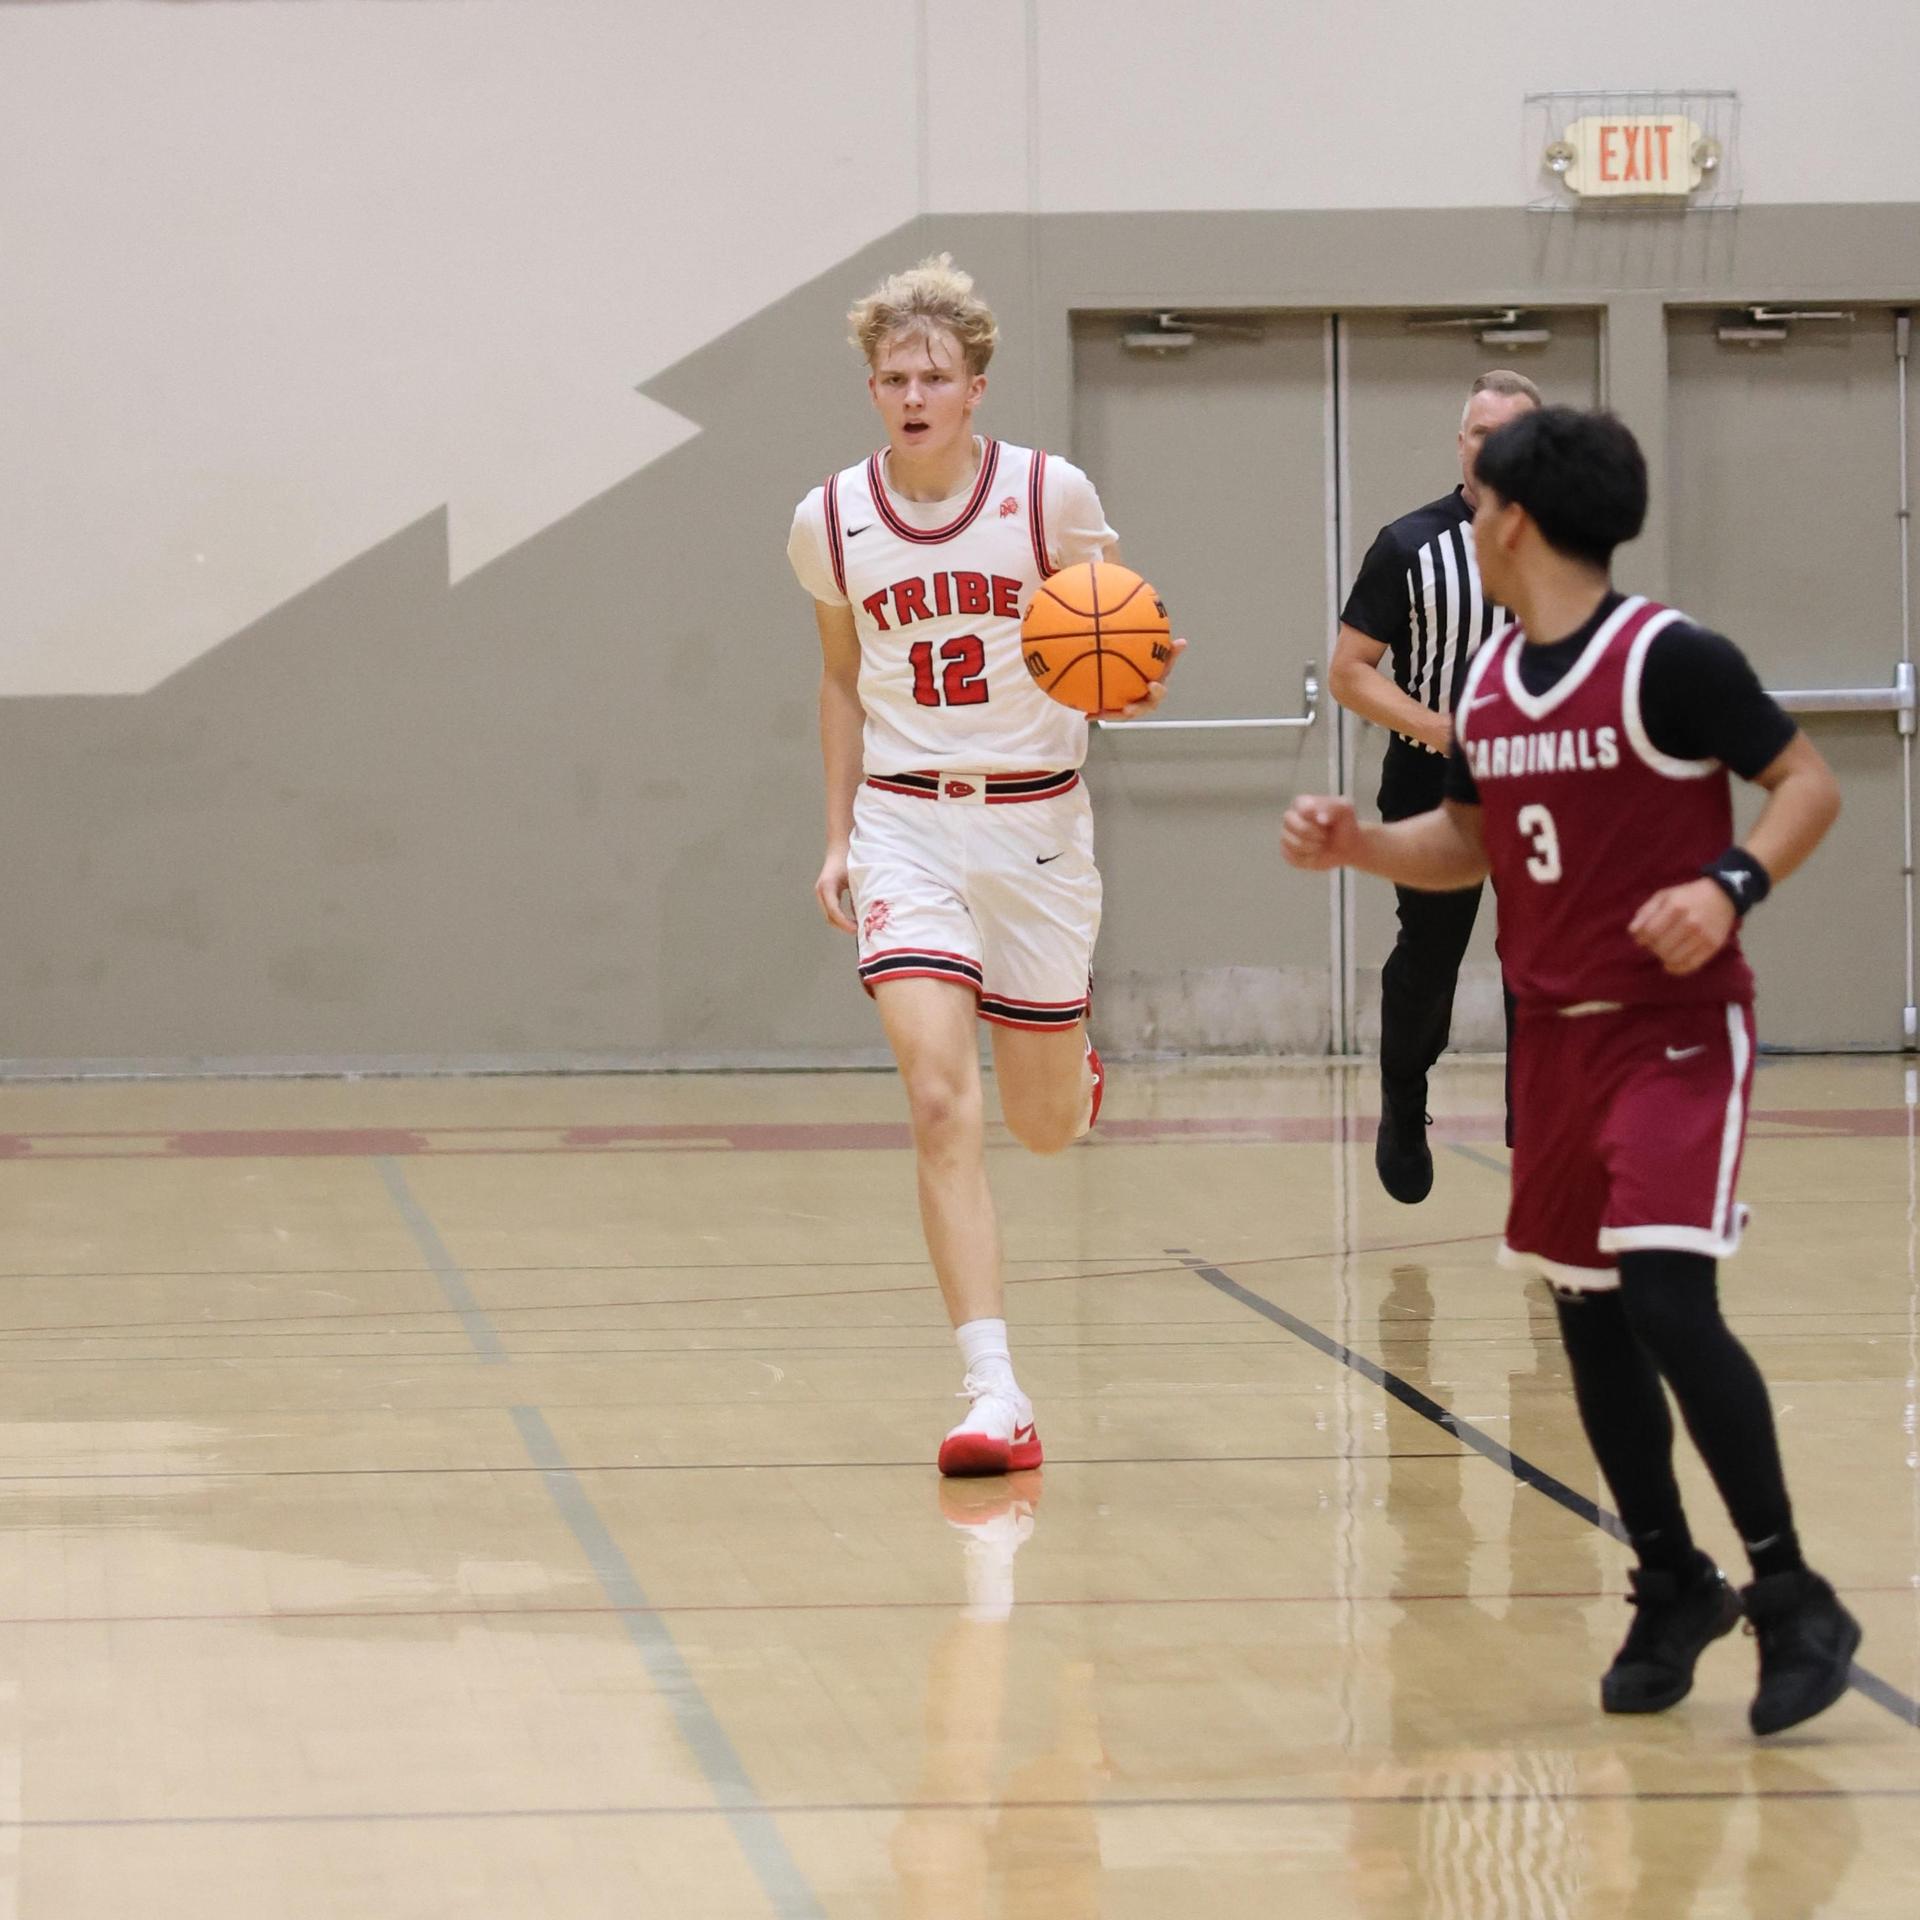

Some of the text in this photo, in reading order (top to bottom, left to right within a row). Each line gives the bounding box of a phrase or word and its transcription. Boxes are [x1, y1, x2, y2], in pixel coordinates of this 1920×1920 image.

[1600, 126, 1672, 181] EXIT
[862, 571, 1023, 631] TRIBE
[908, 634, 989, 707] 12
[1517, 803, 1562, 884] 3
